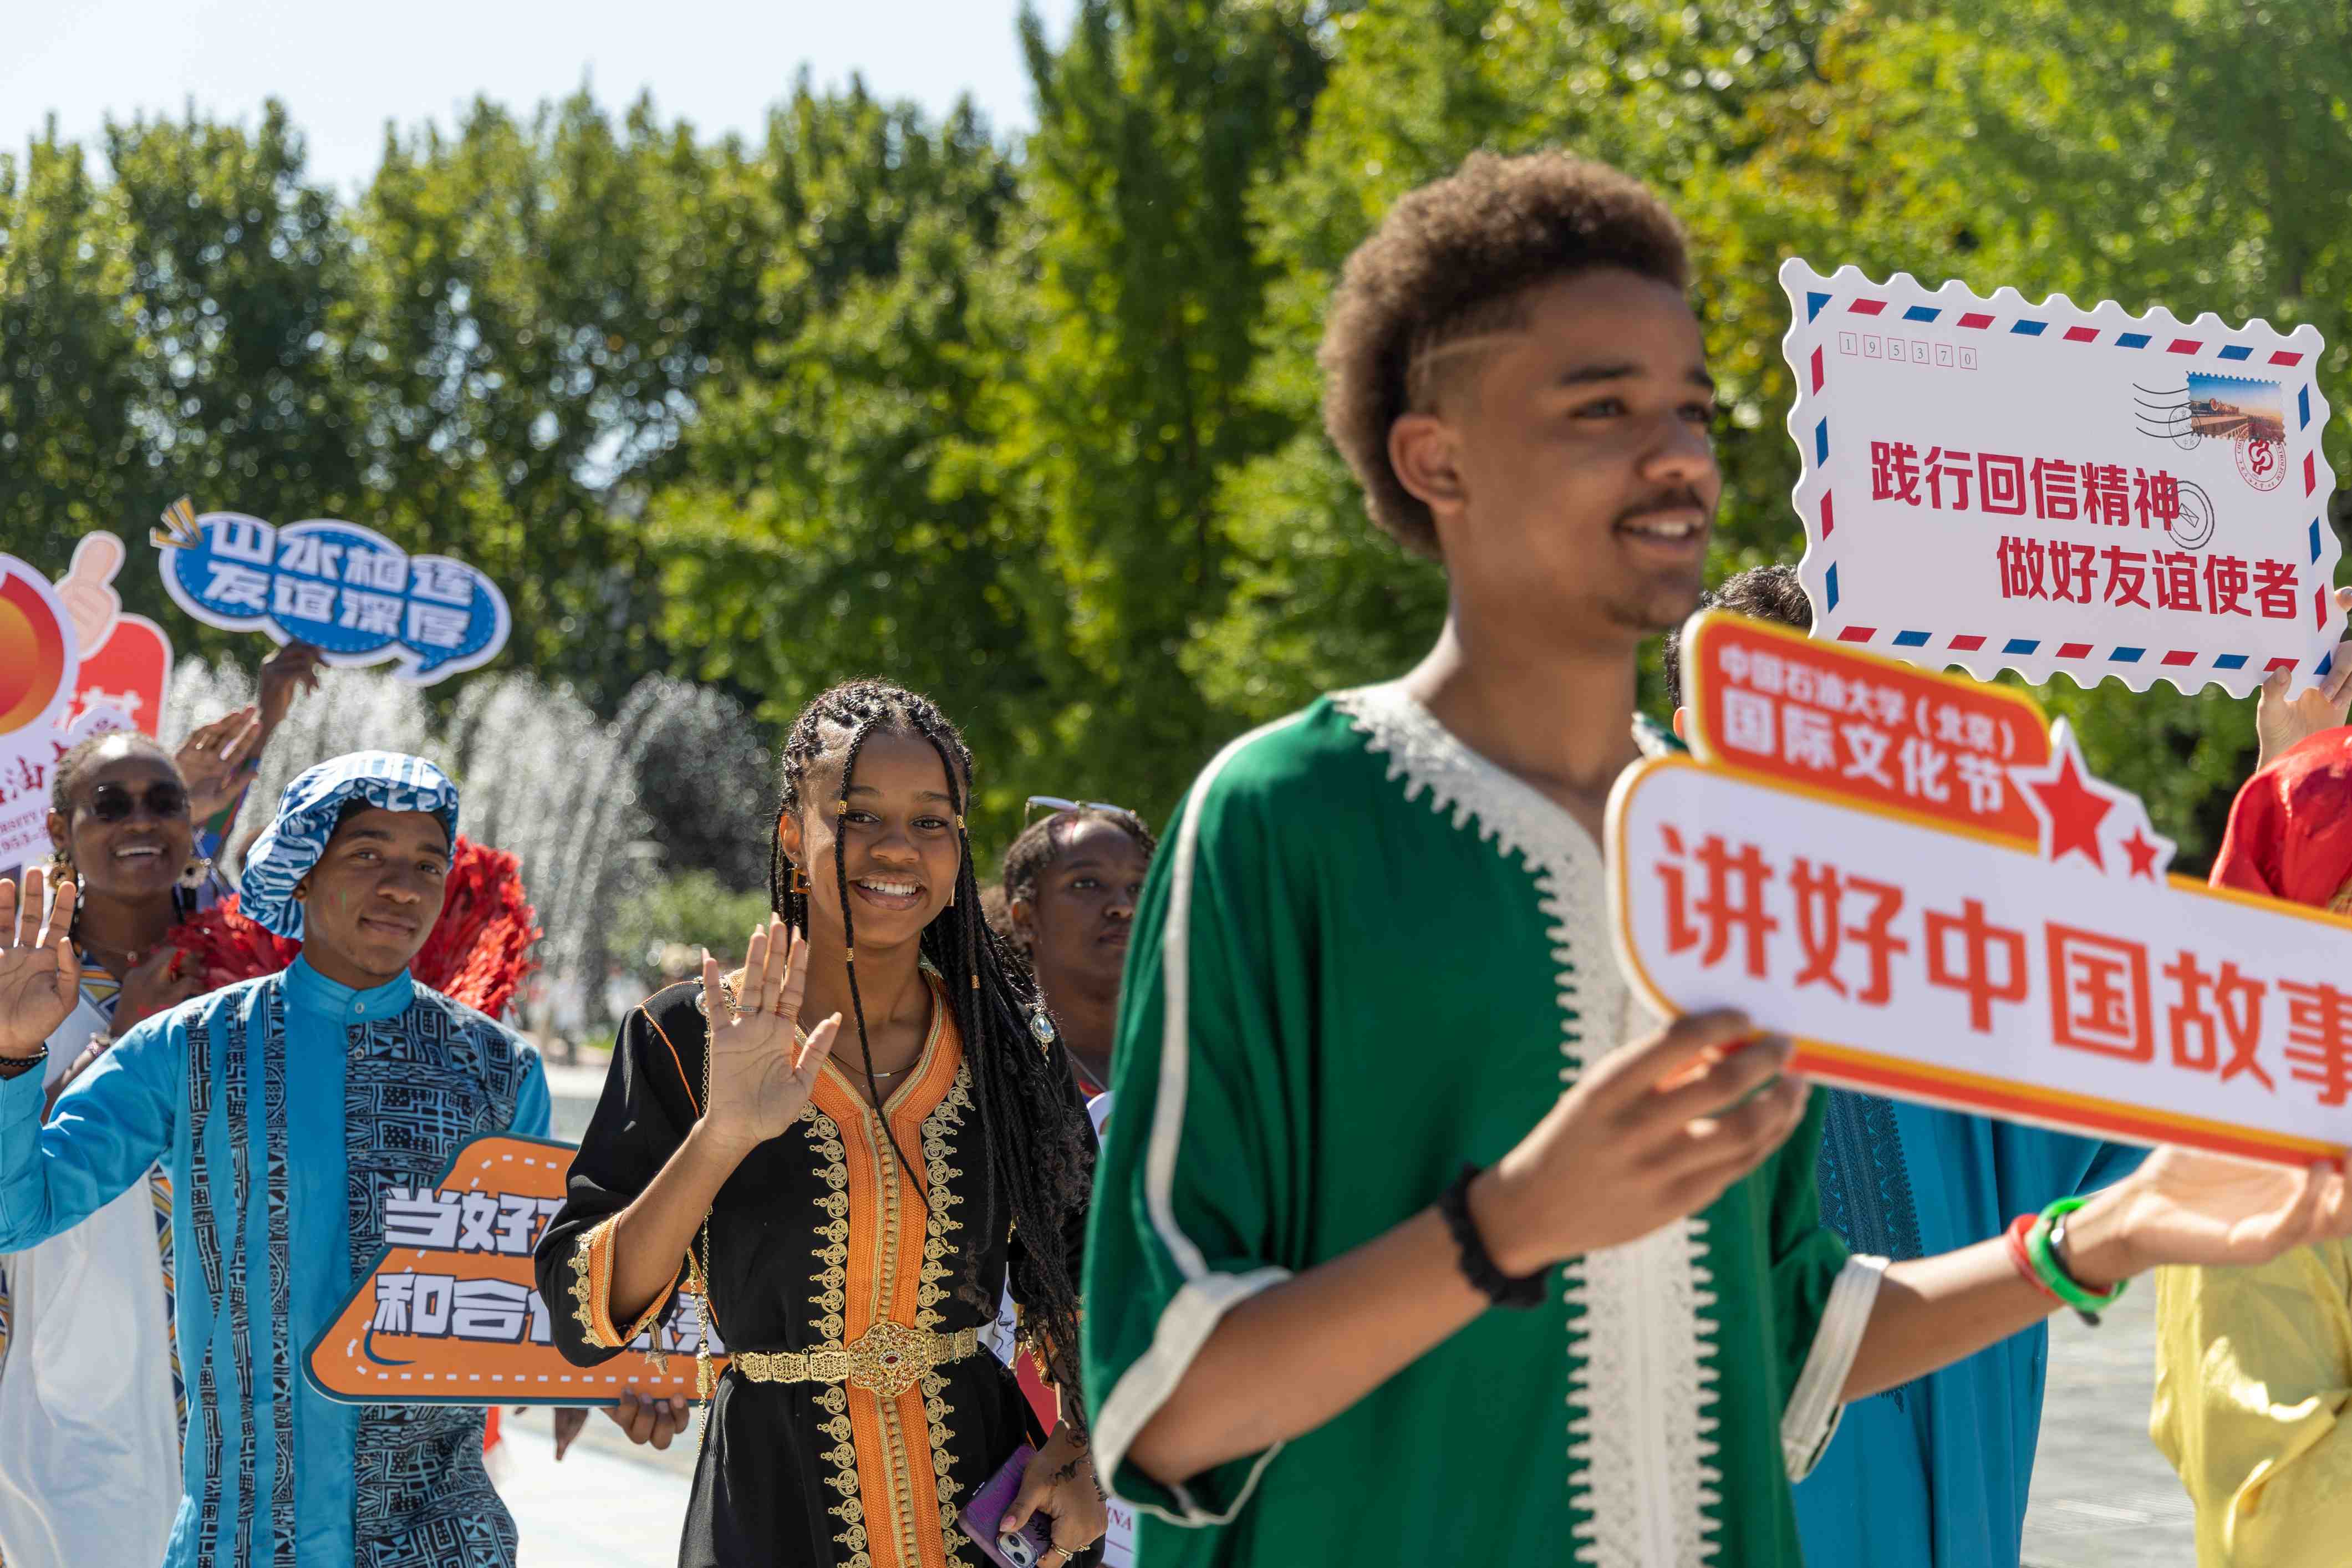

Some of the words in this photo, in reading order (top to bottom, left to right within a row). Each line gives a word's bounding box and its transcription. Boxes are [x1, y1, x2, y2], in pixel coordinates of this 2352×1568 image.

[1846, 338, 1972, 365] 195370
[1870, 441, 2180, 531] 践行回信精神
[202, 560, 472, 650] 友谊深厚
[1996, 536, 2299, 620] 做好友谊使者
[1722, 686, 2004, 813] 国际文化节
[1655, 822, 2352, 1107] 讲好中国故事
[385, 1187, 566, 1254] 当好
